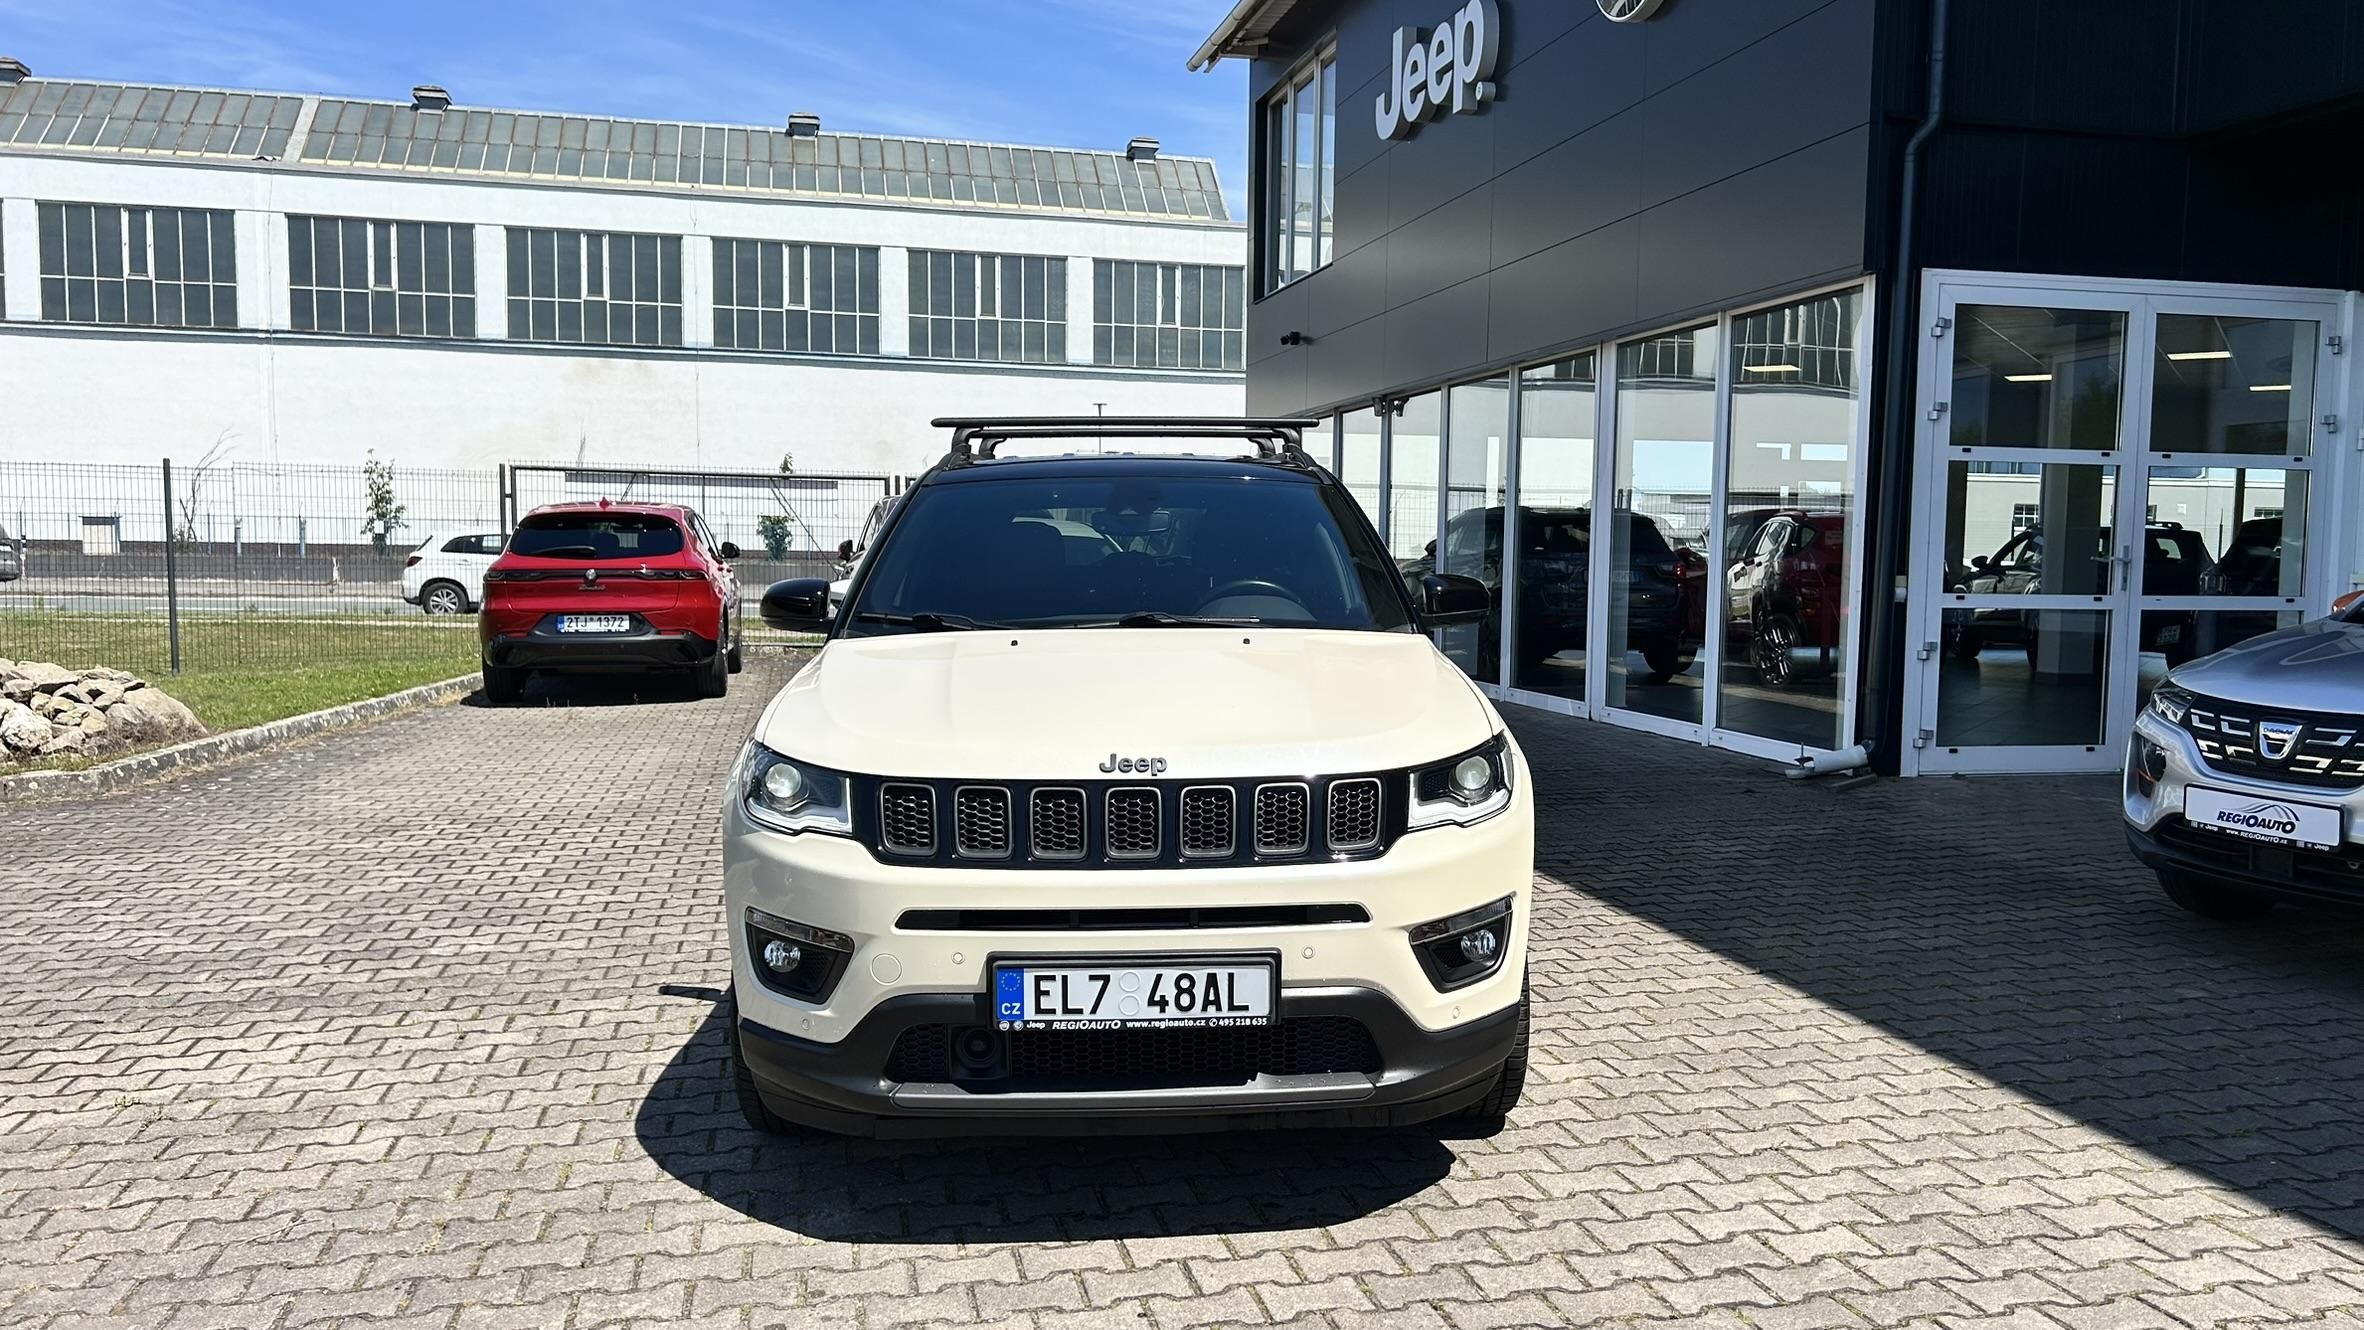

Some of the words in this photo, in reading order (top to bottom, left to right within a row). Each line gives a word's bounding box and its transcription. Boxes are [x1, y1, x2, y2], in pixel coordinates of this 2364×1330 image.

[1375, 0, 1486, 140] Jeep
[566, 616, 588, 628] 2TJ
[597, 616, 625, 628] 1372
[1098, 753, 1168, 777] Jeep
[2216, 810, 2297, 834] REGIOAUTO
[1033, 974, 1111, 1015] EL7
[1147, 972, 1250, 1013] 48AL
[1001, 1002, 1021, 1015] CZ
[1052, 1019, 1121, 1030] REGIOAUTO
[1126, 1018, 1206, 1029] www.regioauto.cz
[1218, 1018, 1234, 1027] 495
[1235, 1018, 1251, 1026] 218
[1251, 1017, 1267, 1026] 635
